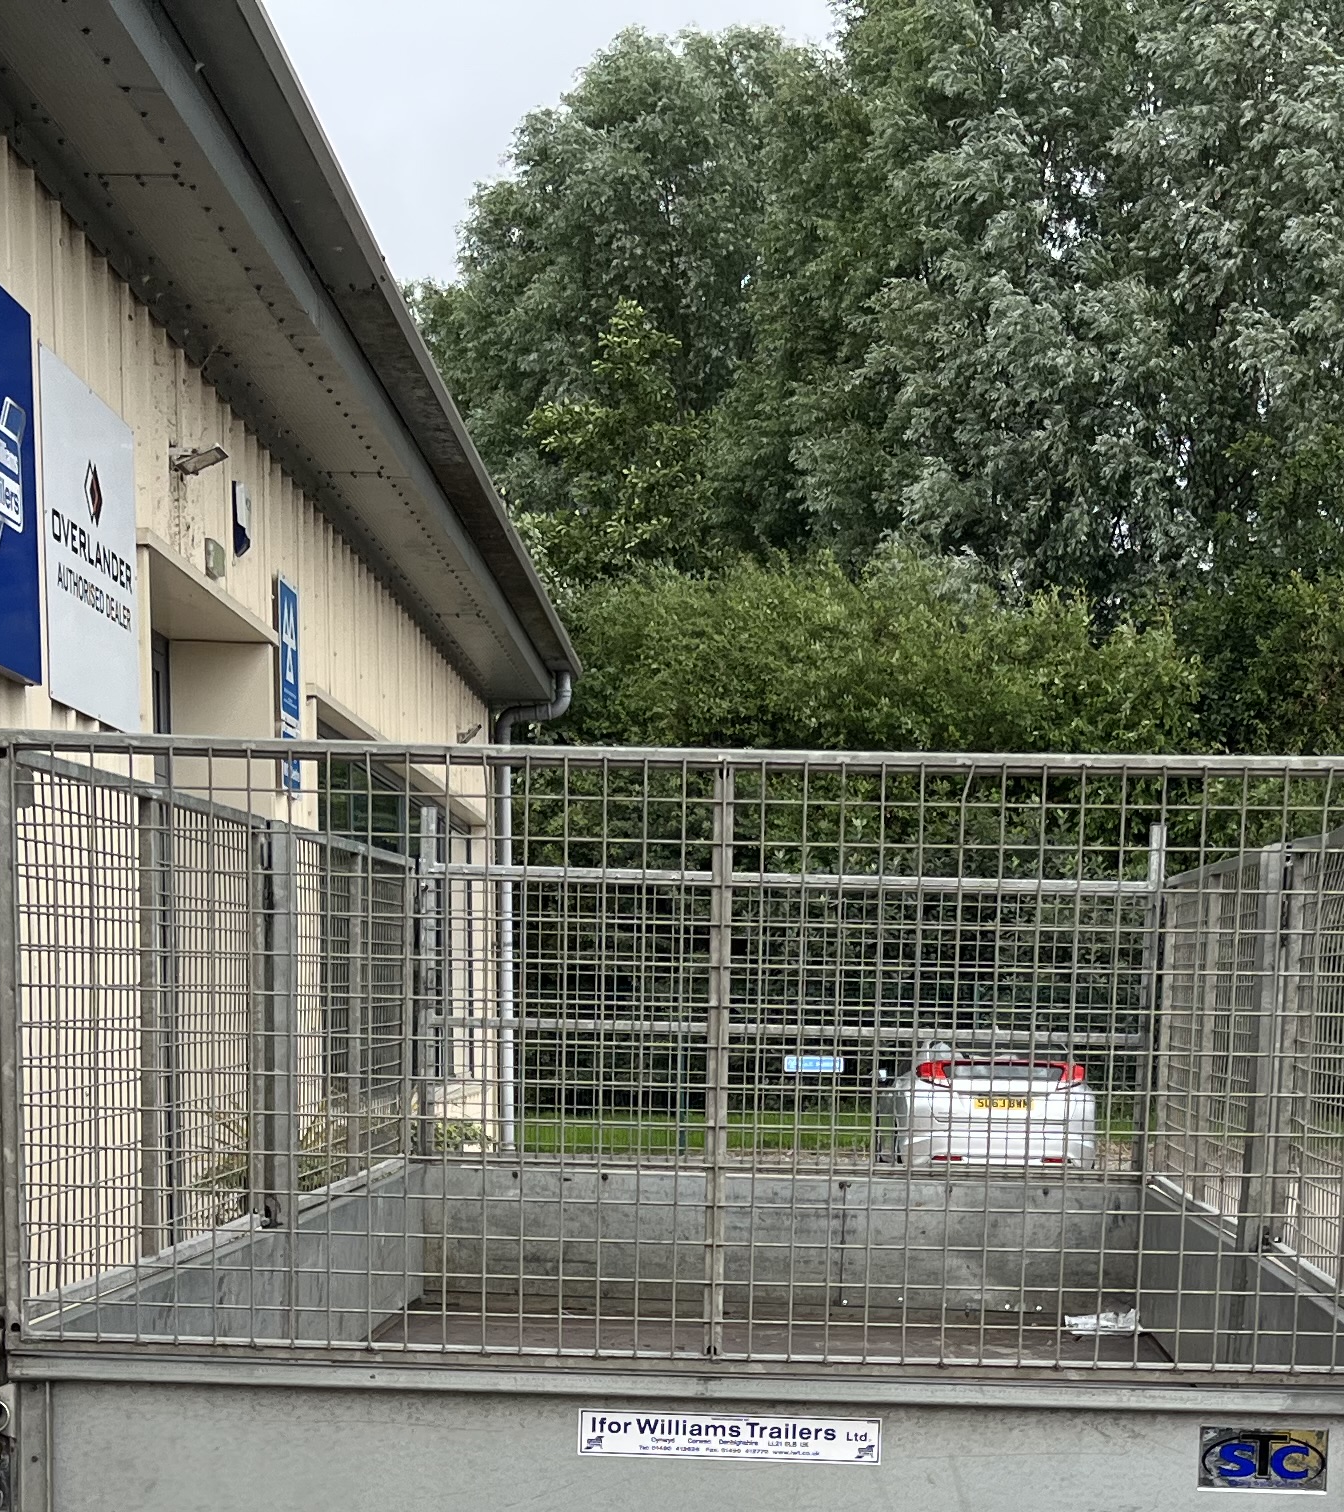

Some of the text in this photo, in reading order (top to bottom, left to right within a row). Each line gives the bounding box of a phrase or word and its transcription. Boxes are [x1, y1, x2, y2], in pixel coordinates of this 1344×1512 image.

[51, 508, 133, 594] OVERLANDER
[57, 562, 132, 632] AUTHORISED DEALER
[591, 1416, 632, 1434] Ifor
[636, 1418, 741, 1438] Williams
[746, 1422, 837, 1441] Trailers
[1219, 1431, 1310, 1480] STC
